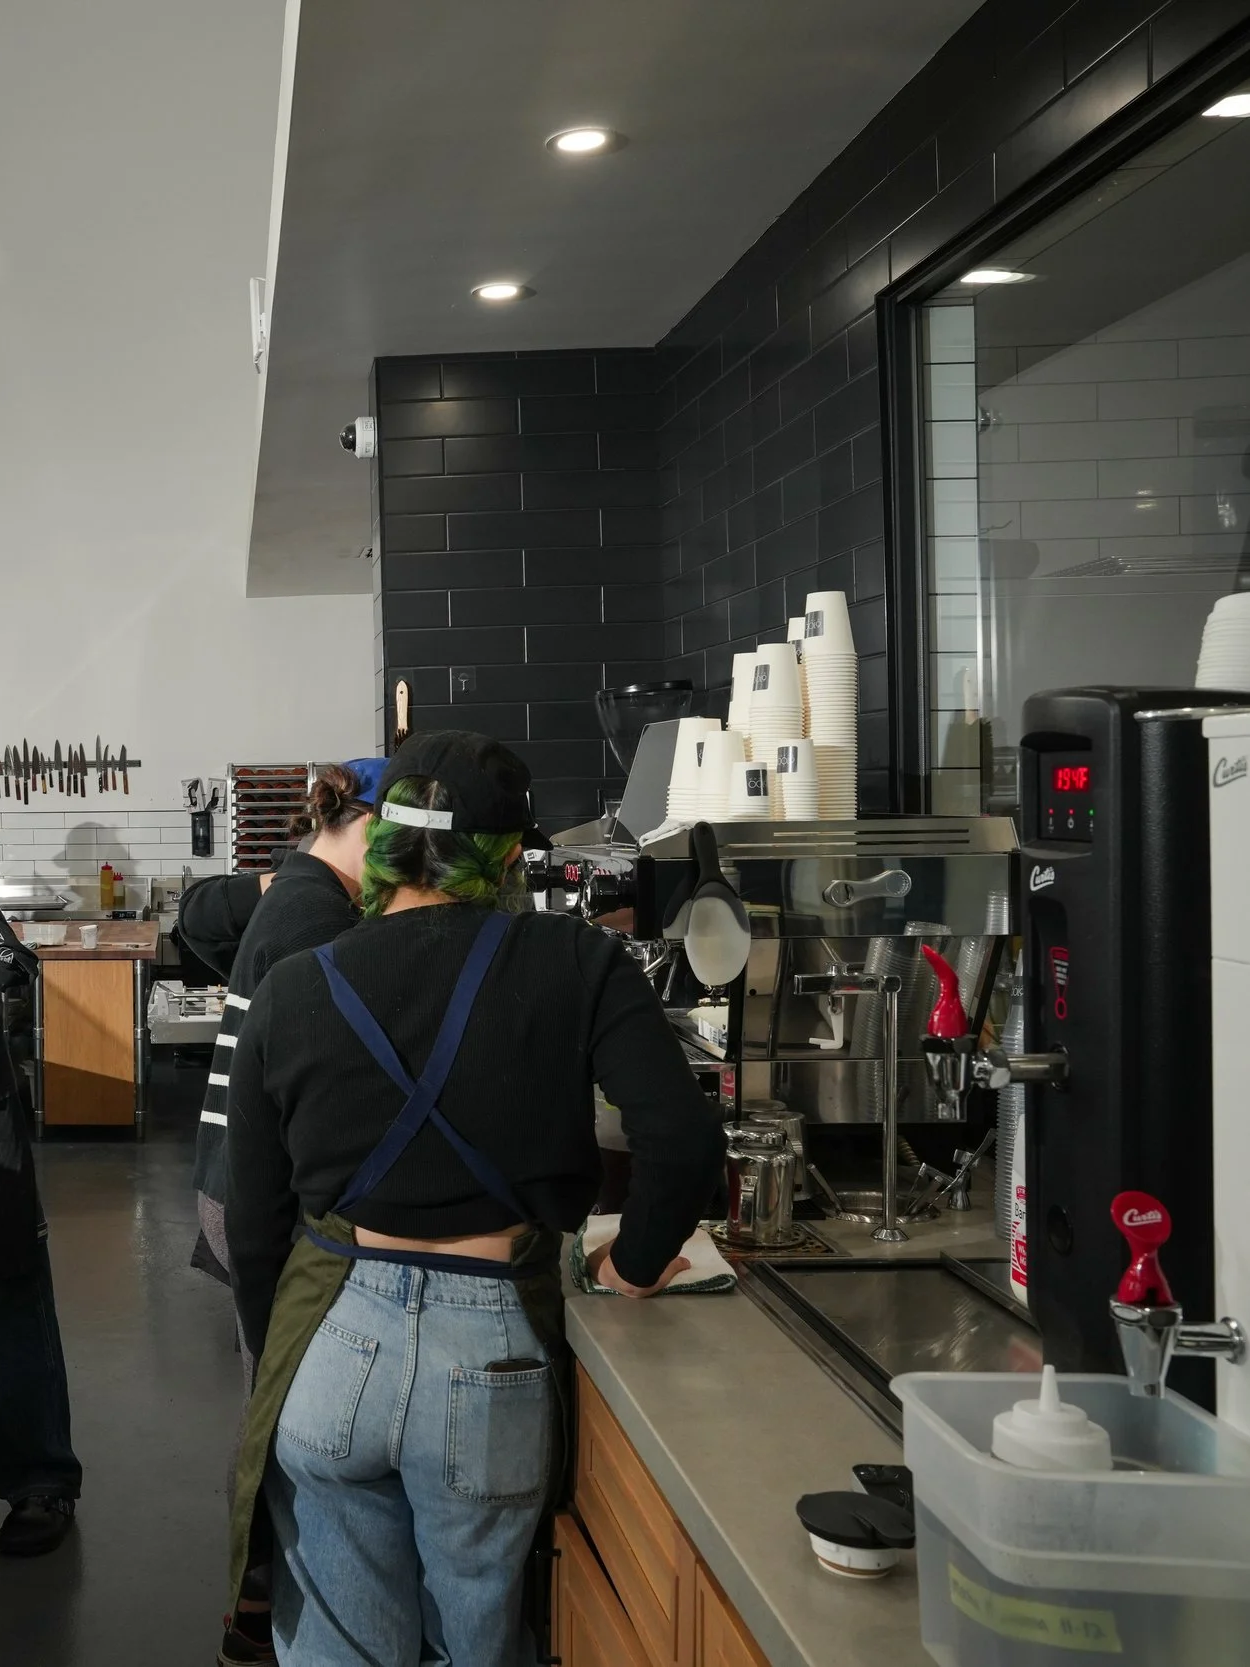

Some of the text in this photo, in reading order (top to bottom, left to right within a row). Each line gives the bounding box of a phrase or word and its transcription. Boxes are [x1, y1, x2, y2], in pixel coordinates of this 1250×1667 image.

[1057, 767, 1089, 790] 194F
[1030, 865, 1055, 891] Curtis
[1122, 1208, 1162, 1226] Curtis
